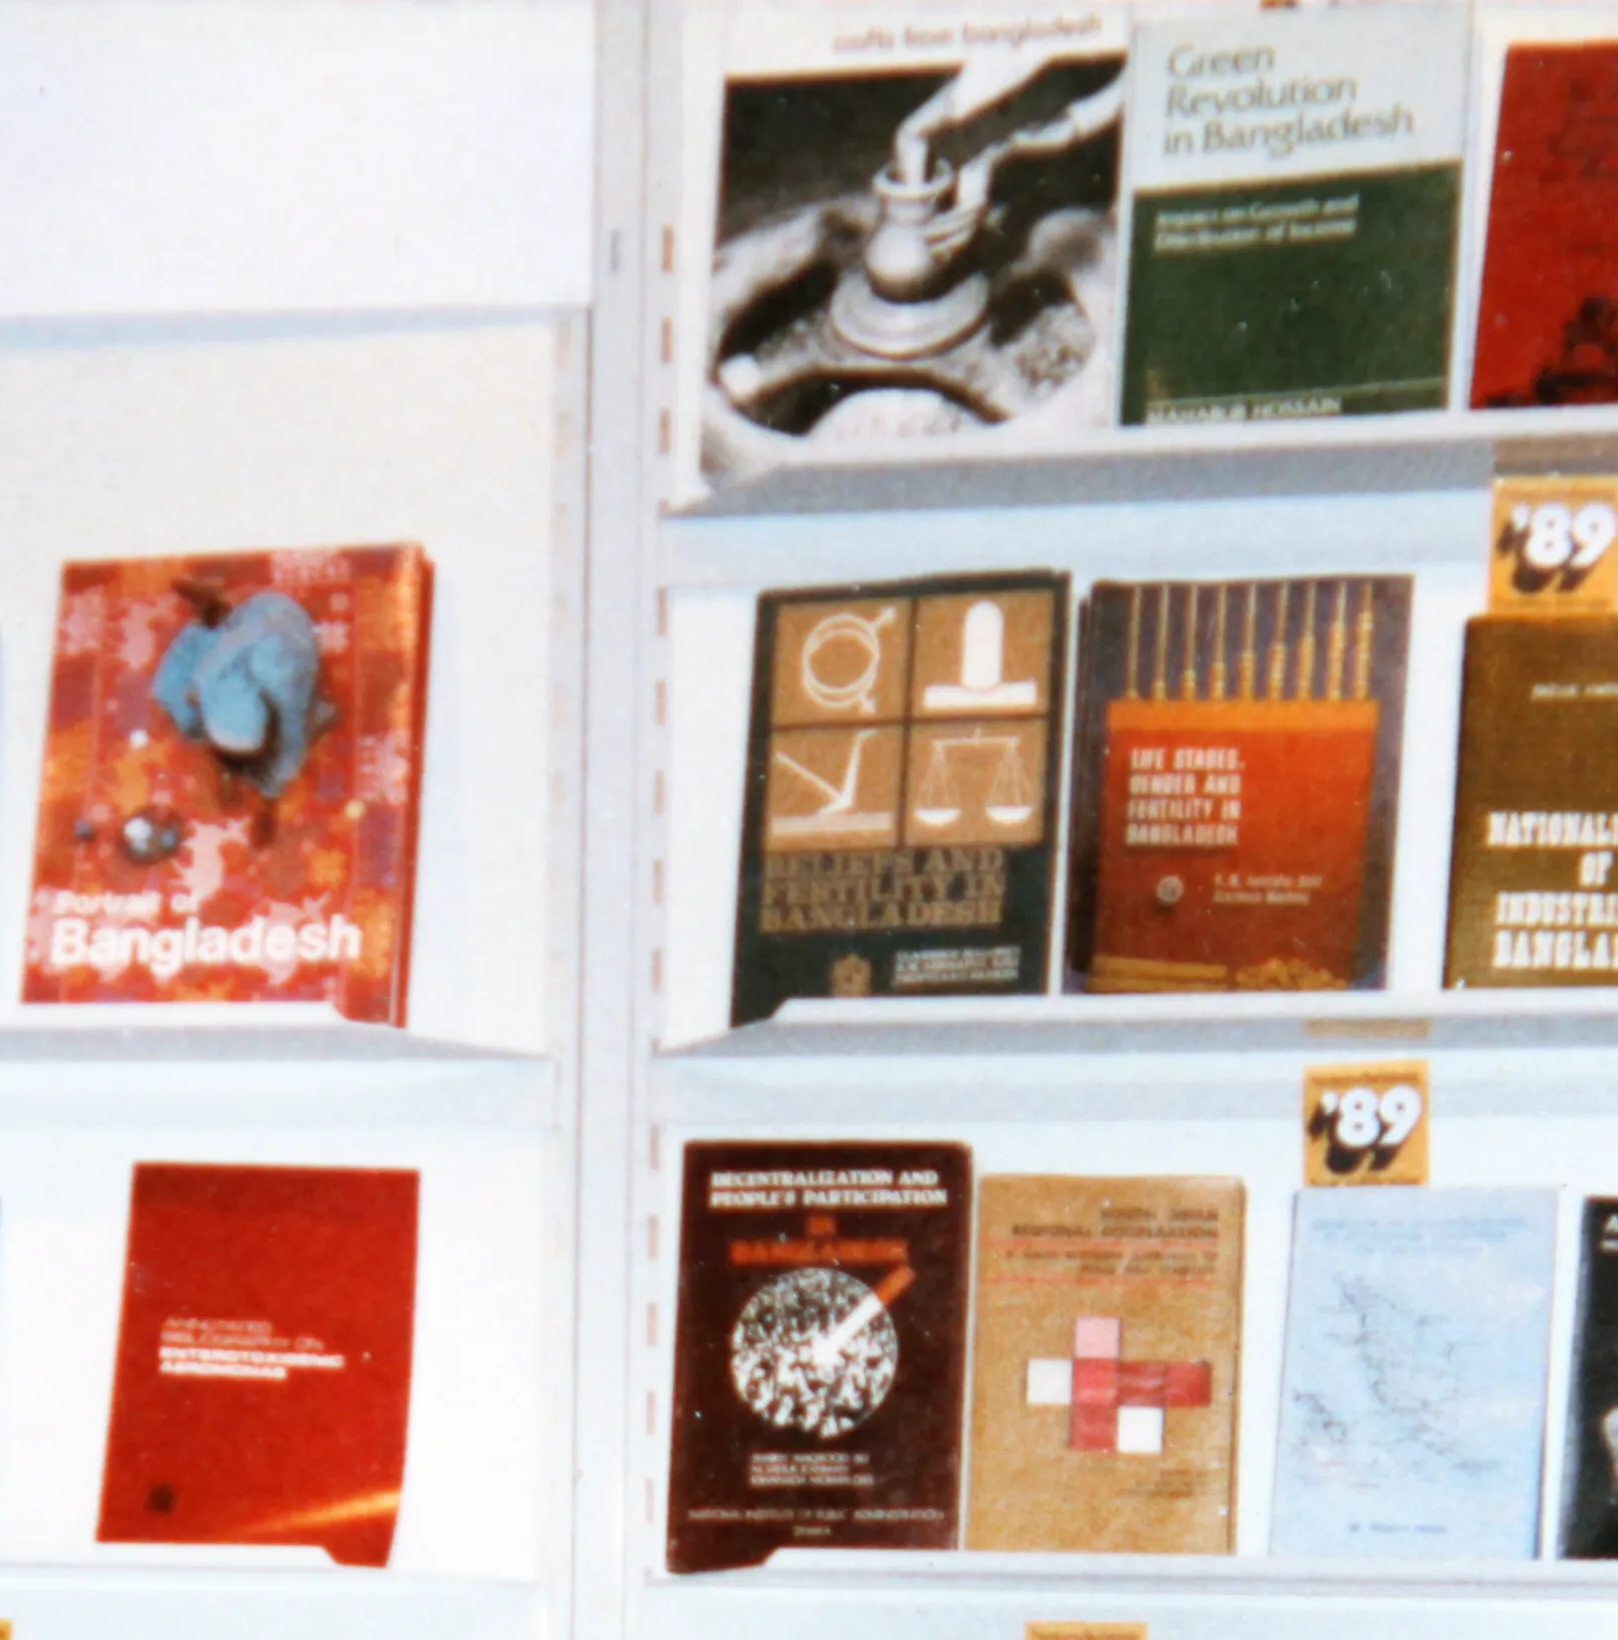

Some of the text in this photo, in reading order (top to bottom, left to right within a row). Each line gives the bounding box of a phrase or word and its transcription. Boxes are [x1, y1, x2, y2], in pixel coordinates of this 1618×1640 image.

[1166, 44, 1274, 77] Green
[1165, 74, 1360, 118] Revolution
[1162, 106, 1415, 162] in Bangladesh
[1509, 503, 1618, 568] '89
[1204, 772, 1242, 796] AND
[918, 846, 1004, 877] AND
[1579, 852, 1614, 887] OF
[761, 877, 954, 908] FERTILITY
[759, 901, 1003, 933] BANGLADESH
[49, 913, 363, 974] Bangladesh
[1320, 1084, 1422, 1148] '89
[709, 1168, 939, 1188] DECENTRALIZATION AND
[802, 1187, 948, 1207] PARTICIPATION
